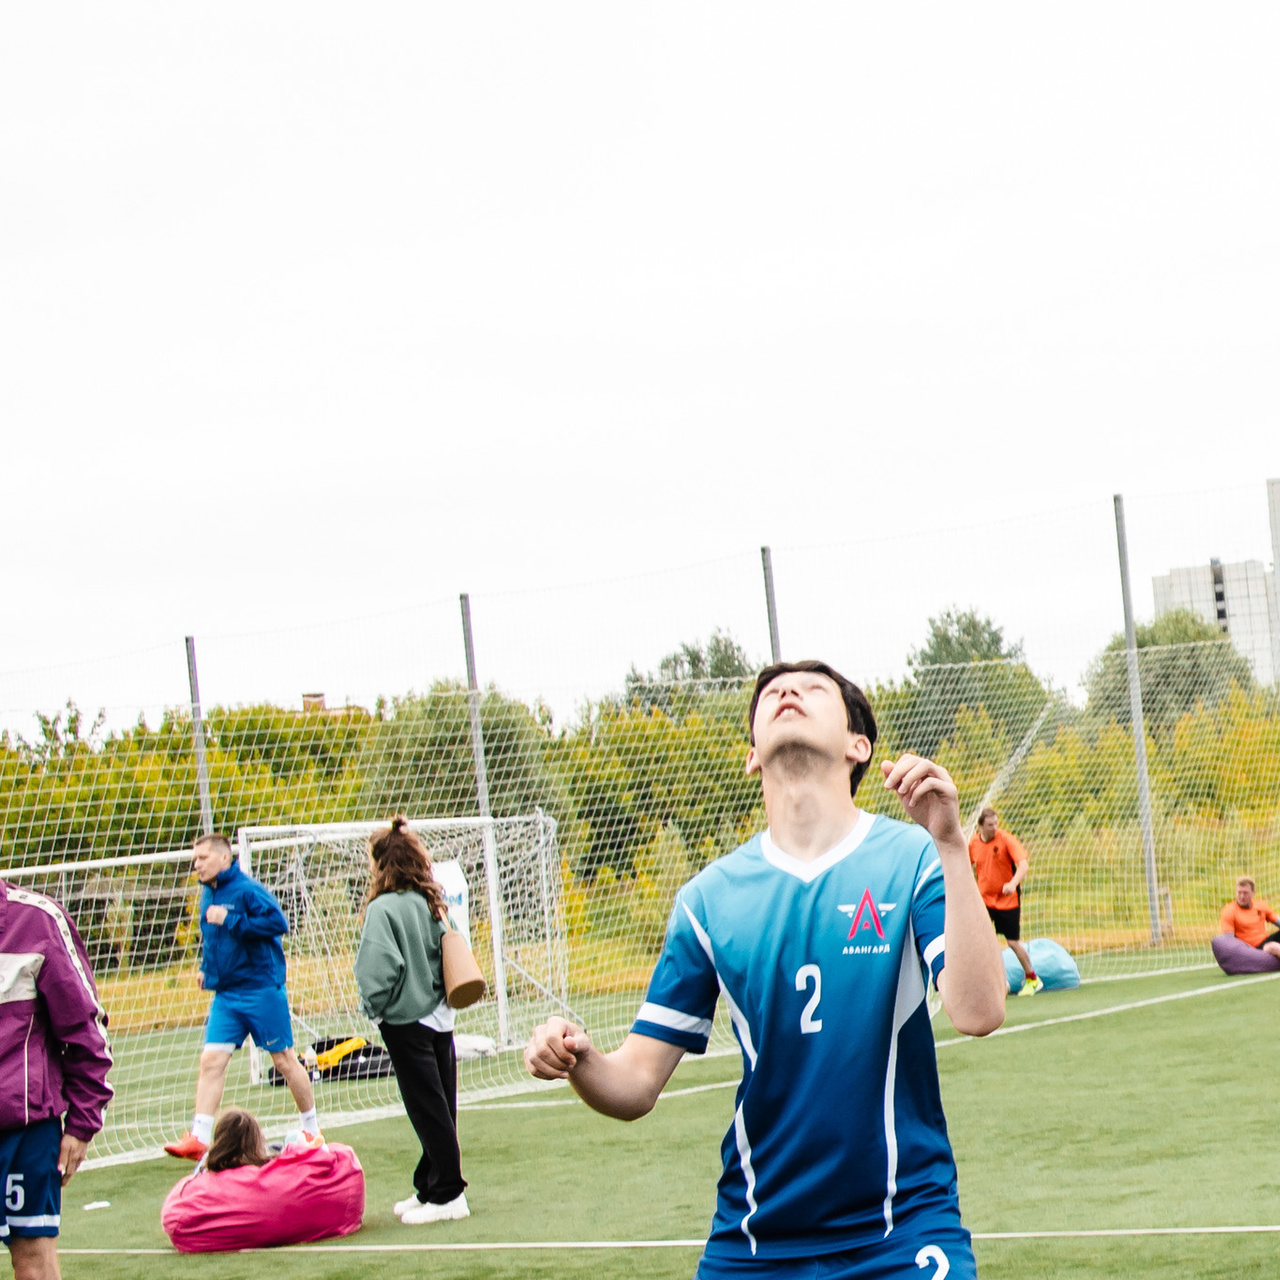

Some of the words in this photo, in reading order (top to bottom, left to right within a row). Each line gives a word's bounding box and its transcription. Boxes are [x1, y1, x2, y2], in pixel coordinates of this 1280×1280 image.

[842, 943, 890, 955] АВАНГАРД
[795, 963, 823, 1035] 2
[5, 1173, 25, 1211] 5
